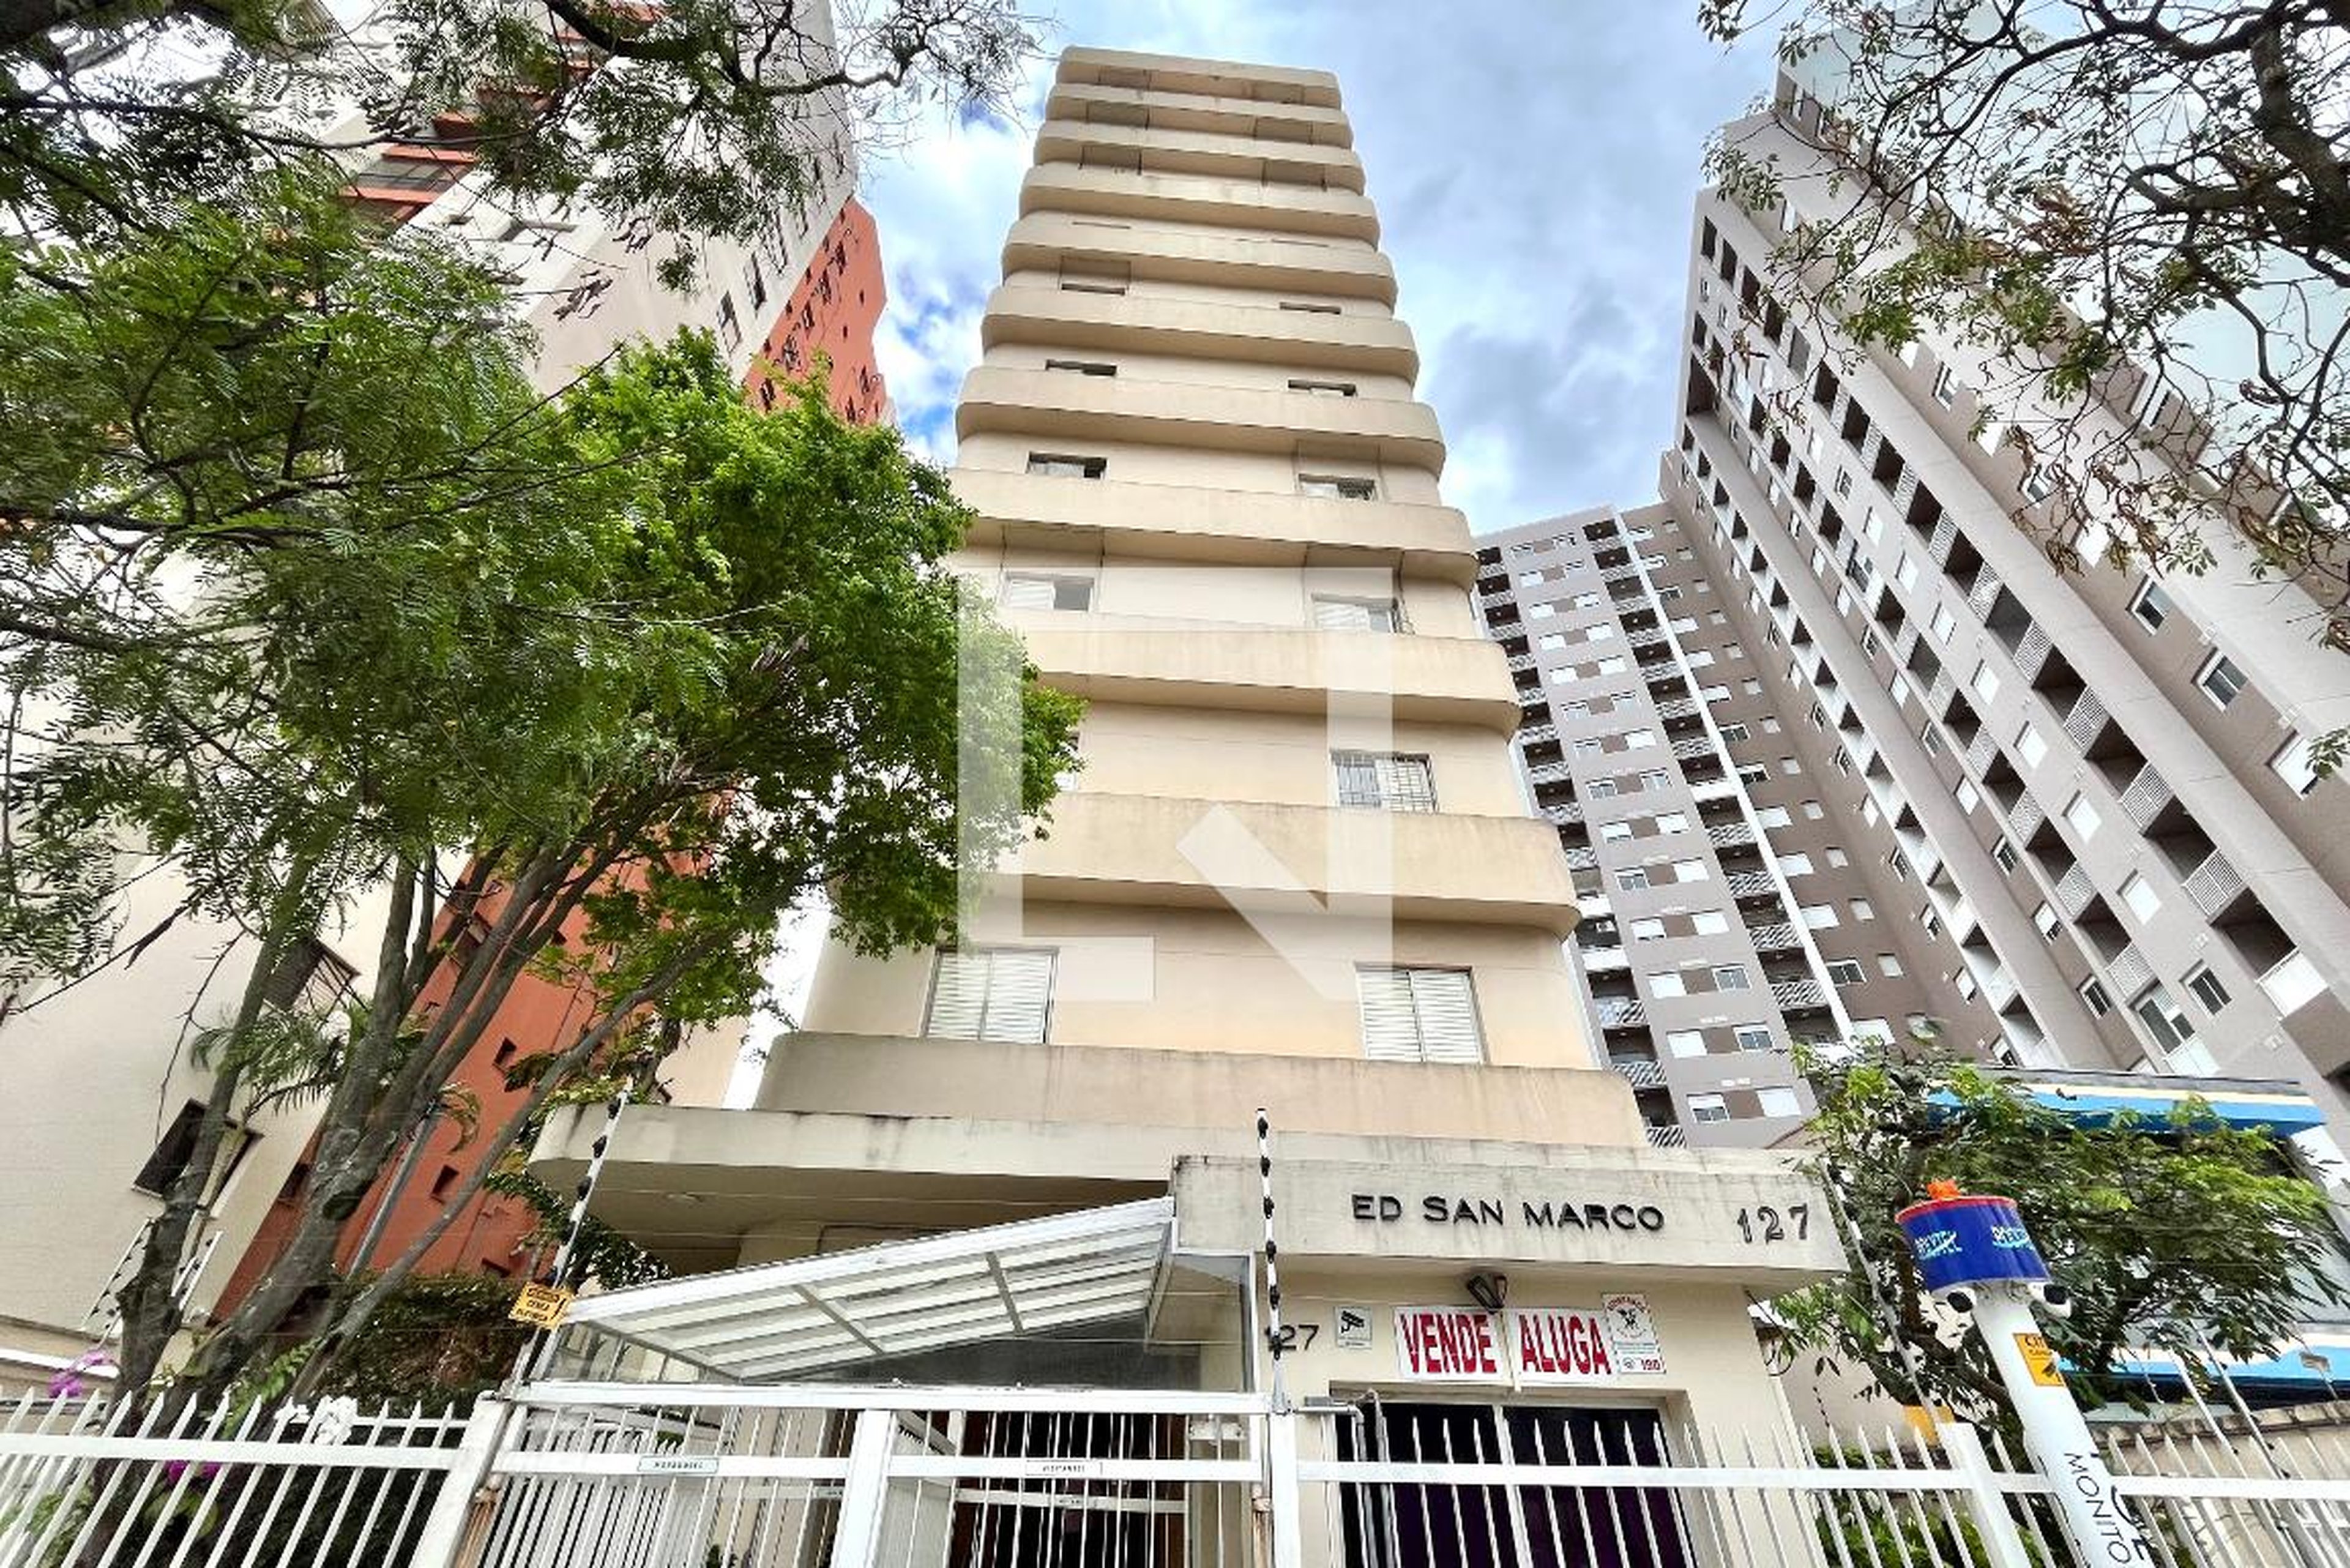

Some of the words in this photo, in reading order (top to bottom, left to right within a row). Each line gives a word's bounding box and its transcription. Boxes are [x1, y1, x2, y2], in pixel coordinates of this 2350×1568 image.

[1351, 1194, 1402, 1221] ED
[1422, 1195, 1503, 1225] SAN
[1522, 1202, 1665, 1231] MARCO
[1736, 1202, 1808, 1244] 127
[1400, 1313, 1498, 1373] VENDE
[1518, 1314, 1612, 1375] ALUGA
